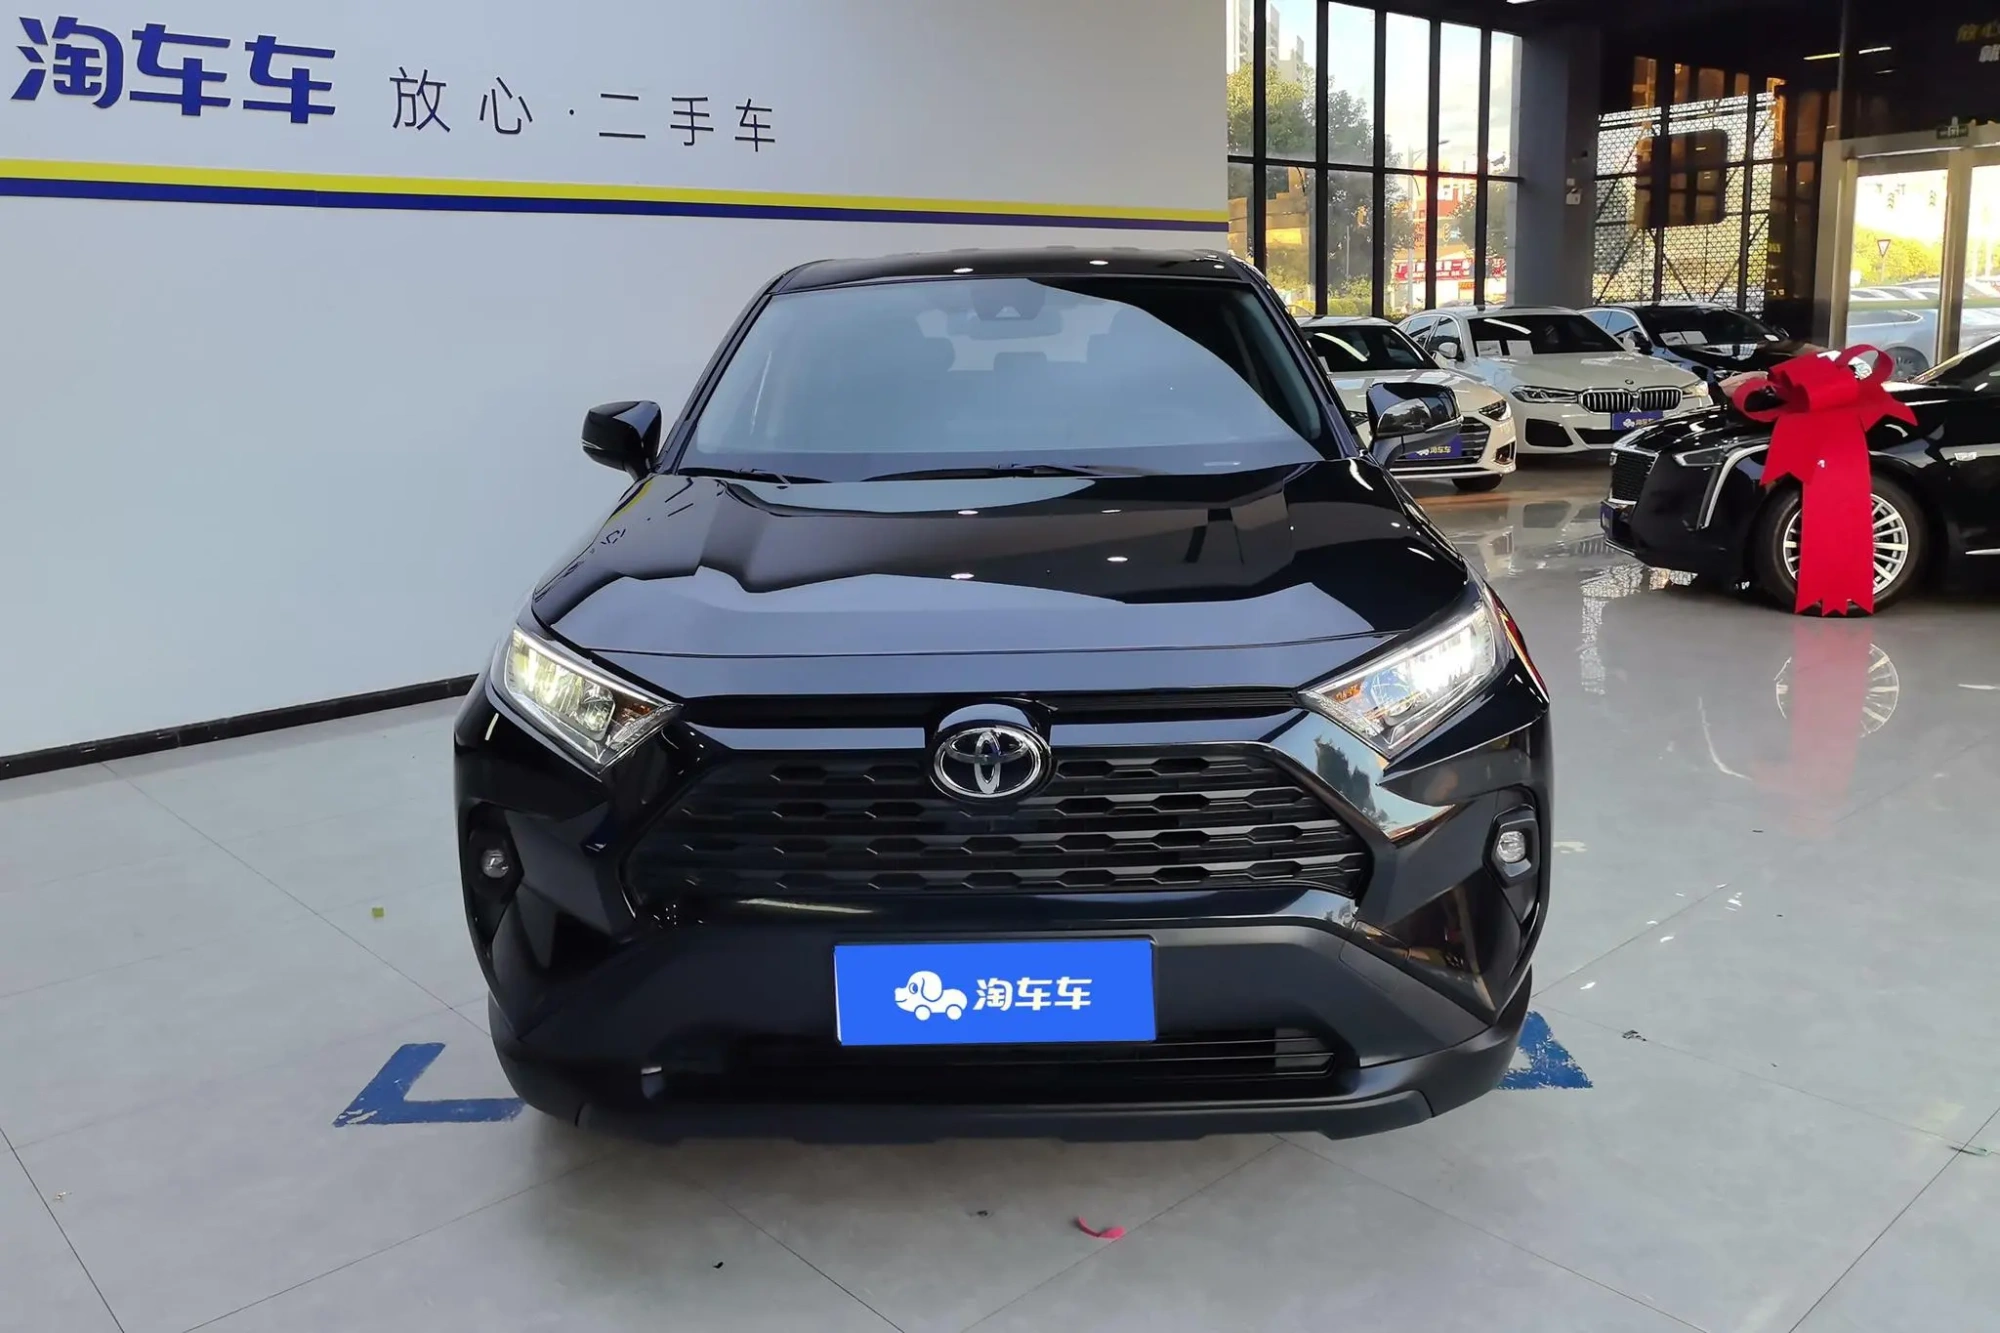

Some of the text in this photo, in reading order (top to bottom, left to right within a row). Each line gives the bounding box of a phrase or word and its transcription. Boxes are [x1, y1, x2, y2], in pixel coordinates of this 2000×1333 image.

[11, 16, 336, 124] 淘车车
[973, 976, 1092, 1011] 淘车车
